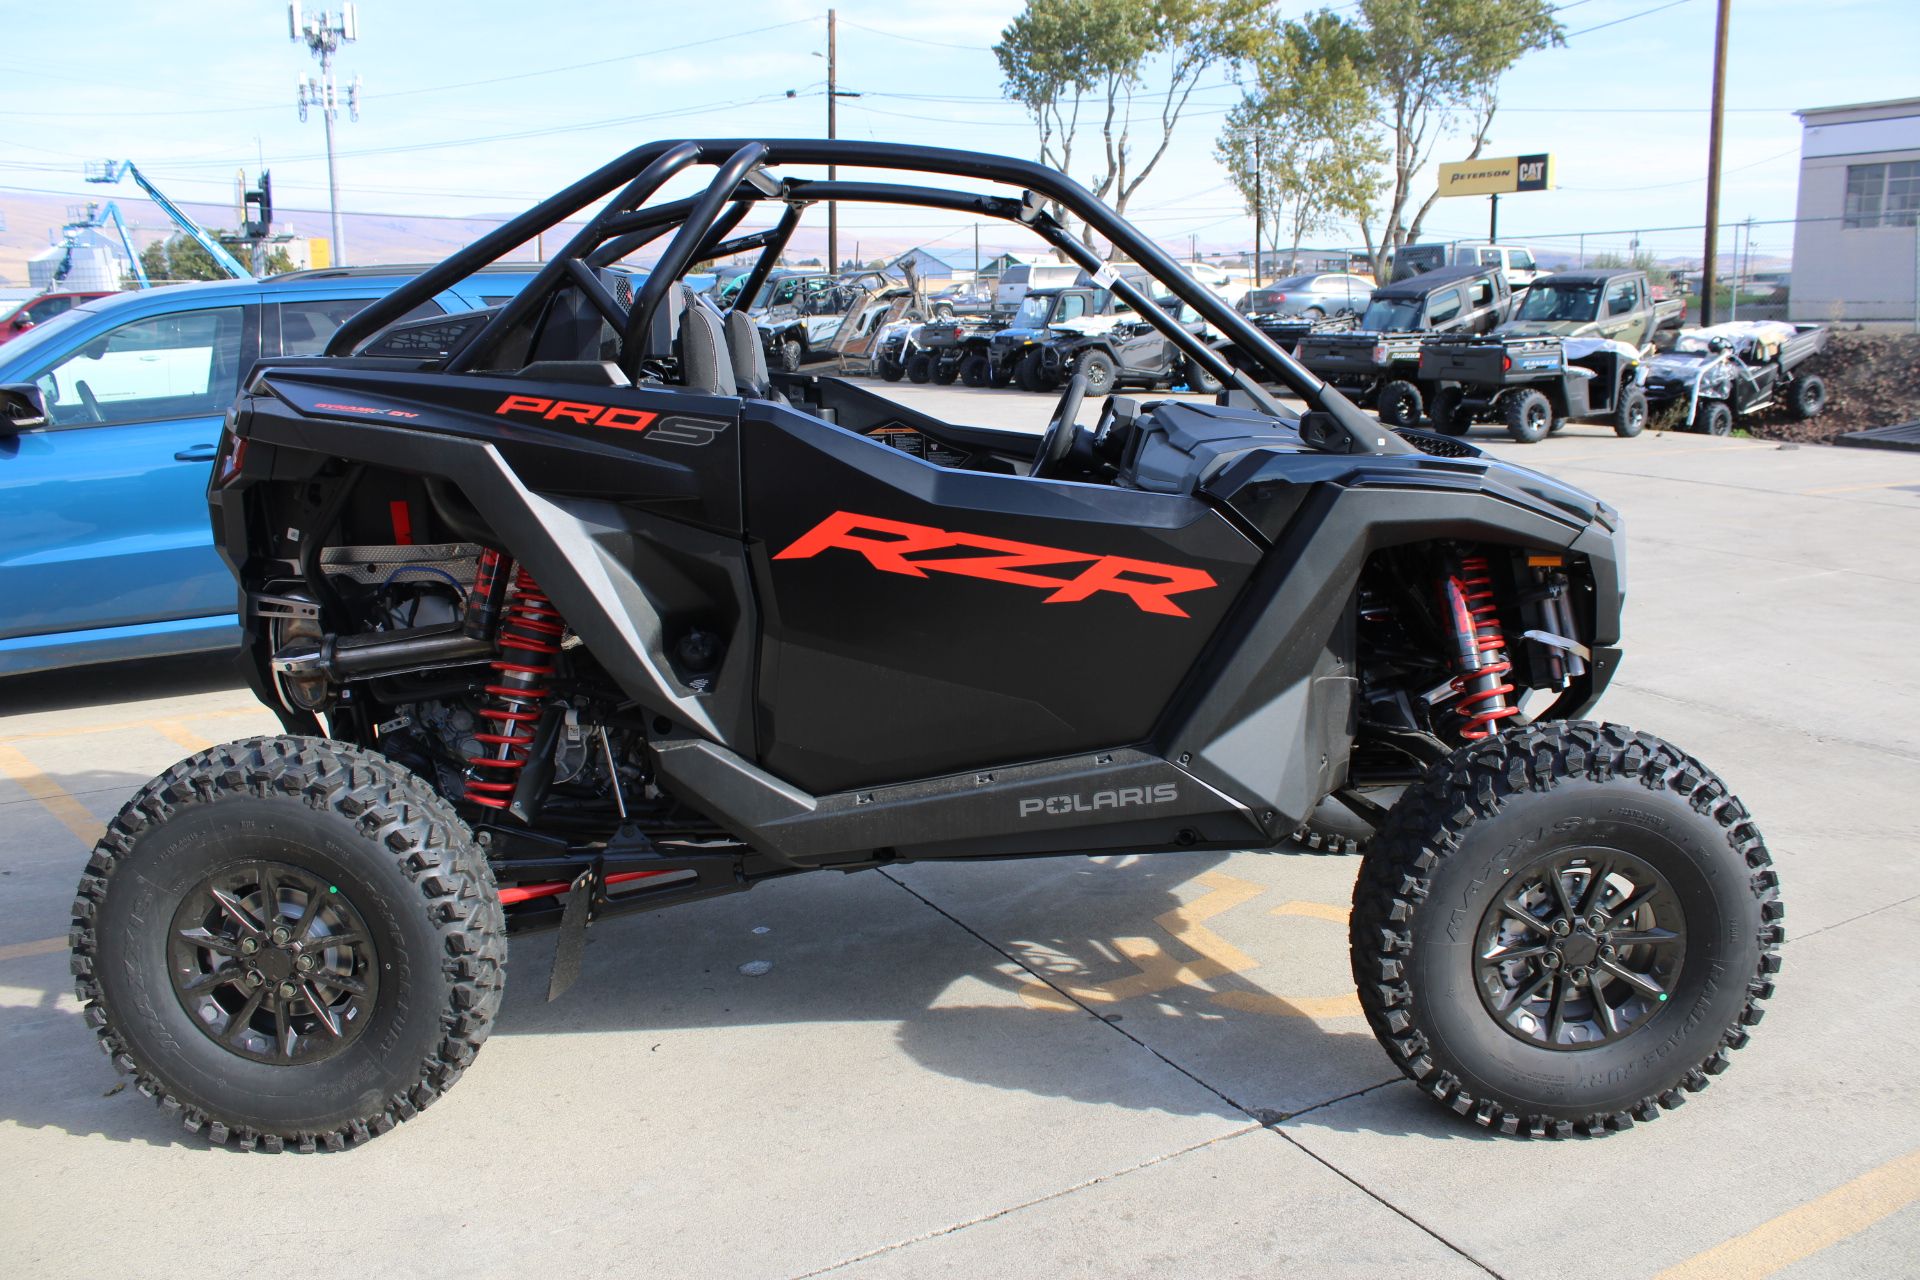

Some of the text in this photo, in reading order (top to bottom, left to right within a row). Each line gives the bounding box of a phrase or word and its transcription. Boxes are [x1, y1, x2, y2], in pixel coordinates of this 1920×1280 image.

[1450, 162, 1544, 185] PETERSON CAT
[1522, 359, 1558, 367] RANGER
[495, 395, 731, 447] PRO S
[772, 510, 1218, 619] RZR
[1019, 783, 1178, 818] POLARIS
[1446, 816, 1582, 943] MAXXIS
